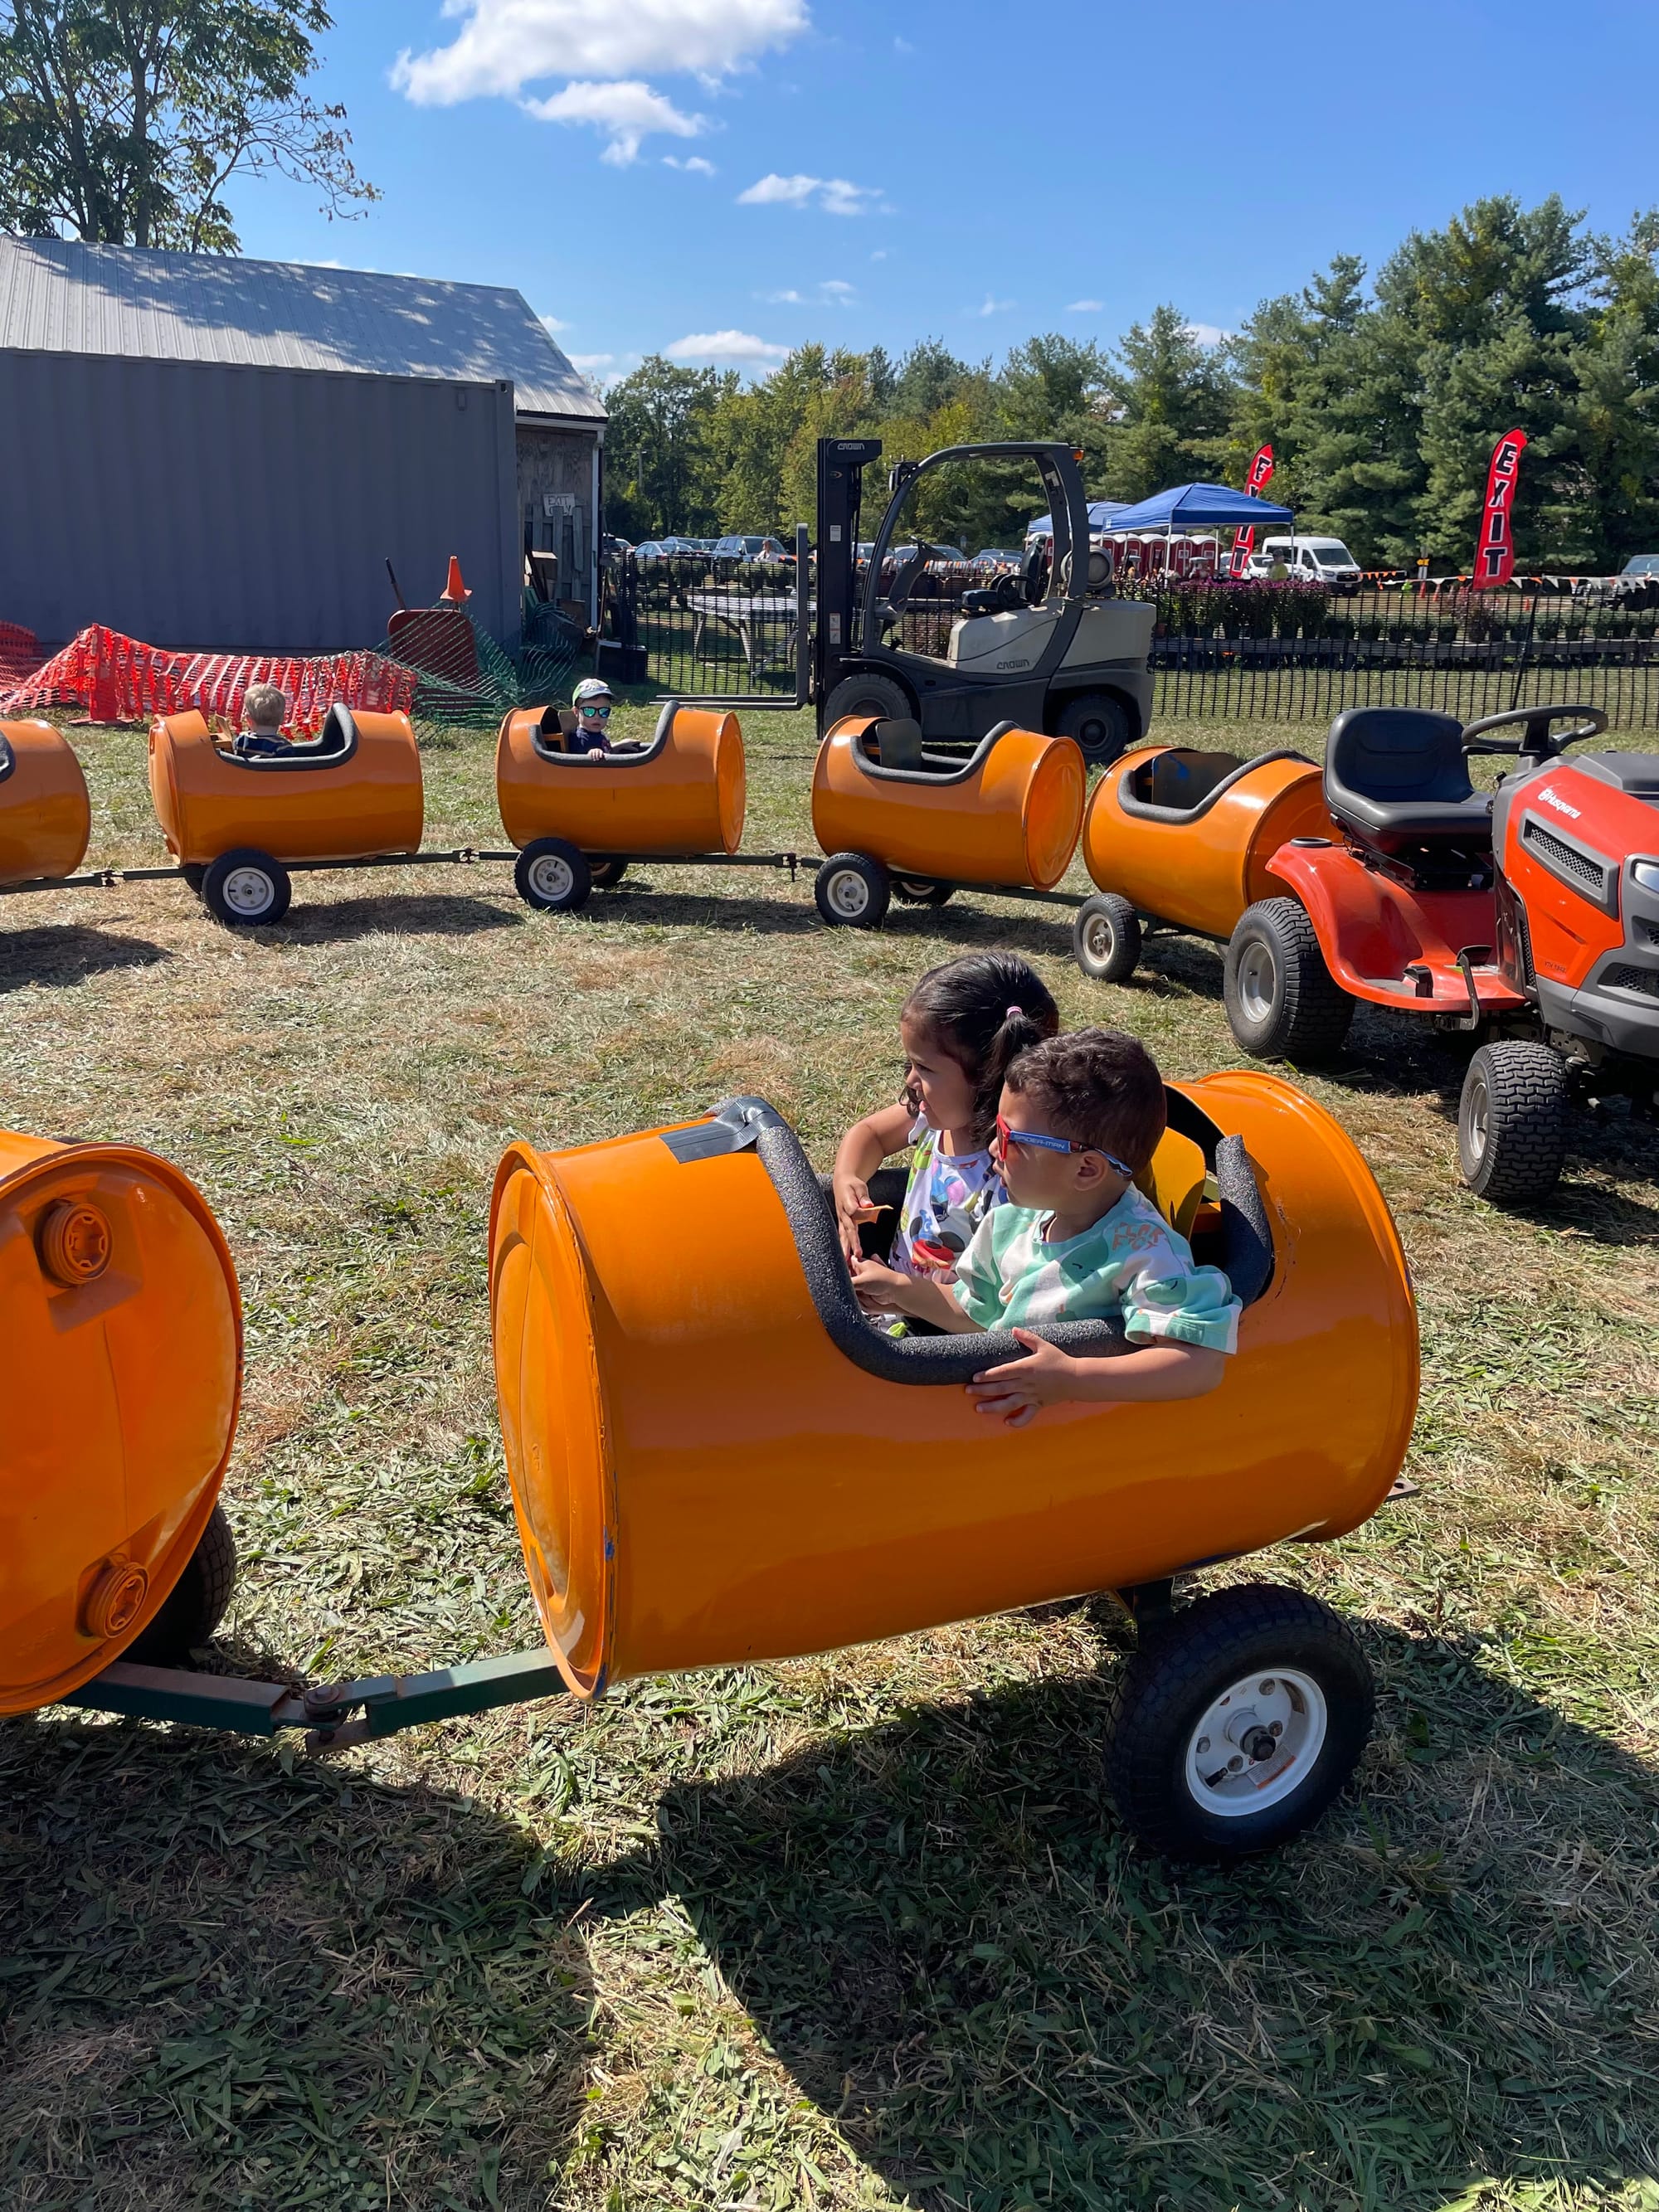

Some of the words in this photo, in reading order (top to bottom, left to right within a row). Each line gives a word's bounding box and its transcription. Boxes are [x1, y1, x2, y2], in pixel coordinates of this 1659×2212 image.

[548, 495, 570, 506] EXIT
[549, 505, 572, 516] OY
[1482, 441, 1519, 576] EXIT
[996, 659, 1030, 669] CROWN
